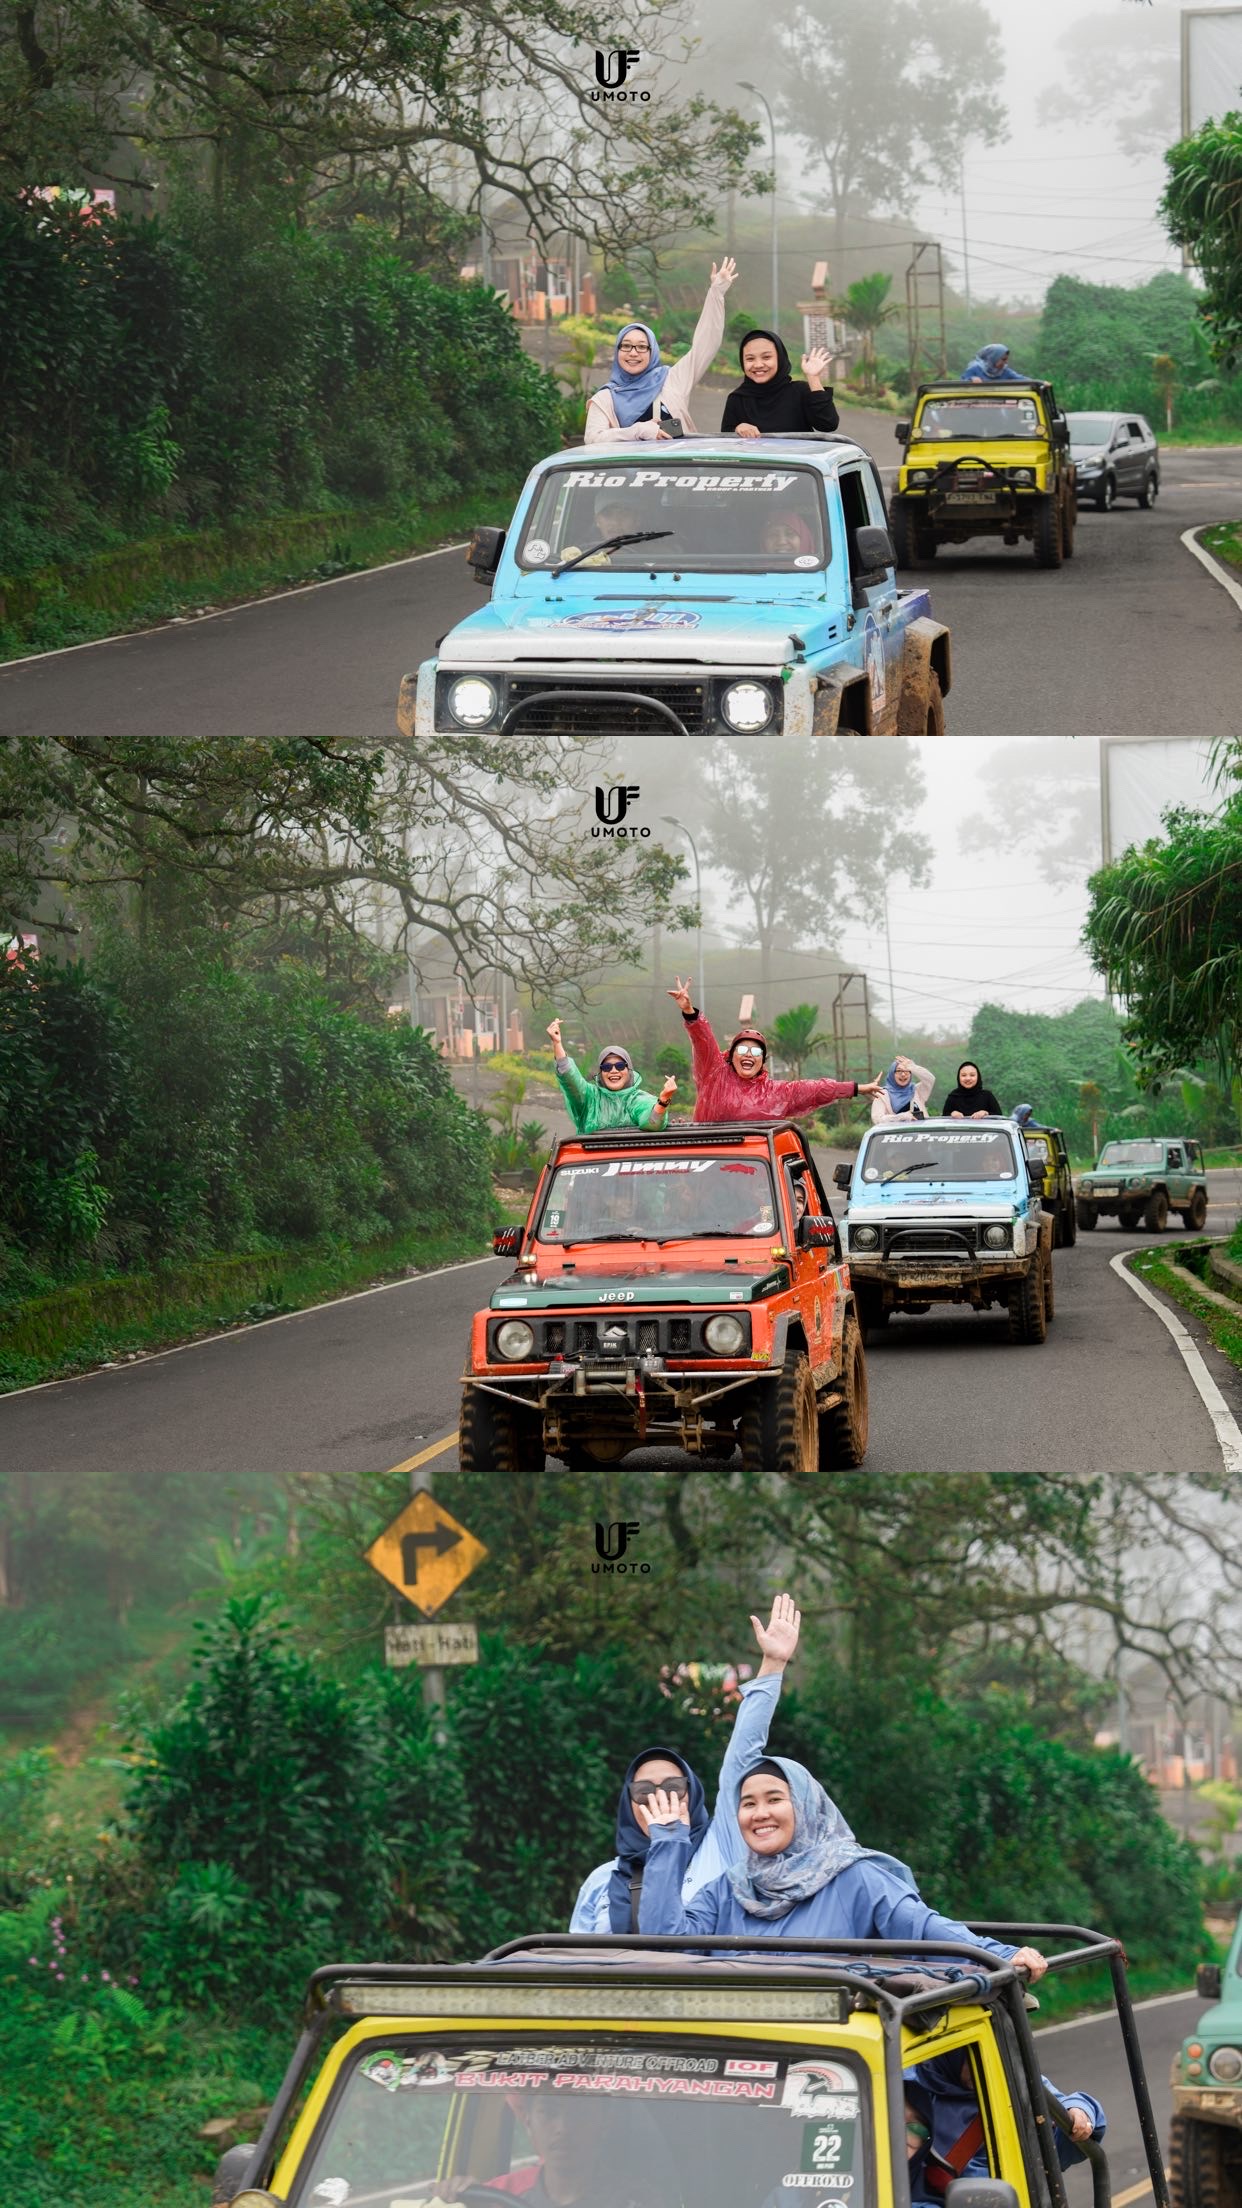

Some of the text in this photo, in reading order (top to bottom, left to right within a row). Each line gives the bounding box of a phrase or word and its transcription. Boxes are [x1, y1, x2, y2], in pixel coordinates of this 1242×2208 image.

[563, 471, 798, 492] Rio Property
[881, 1133, 999, 1144] Rio Property
[560, 1167, 599, 1177] SUZUKI
[601, 1159, 718, 1177] Jimny
[550, 1215, 560, 1225] 19
[599, 1291, 635, 1302] Jeep
[556, 2052, 644, 2070] ADVENTURE
[645, 2057, 718, 2073] OFFROAD
[728, 2061, 776, 2072] IOF
[455, 2071, 775, 2099] BUKIT PARAHYANGAN
[812, 2134, 842, 2162] 22
[783, 2174, 854, 2188] OFFROAD
